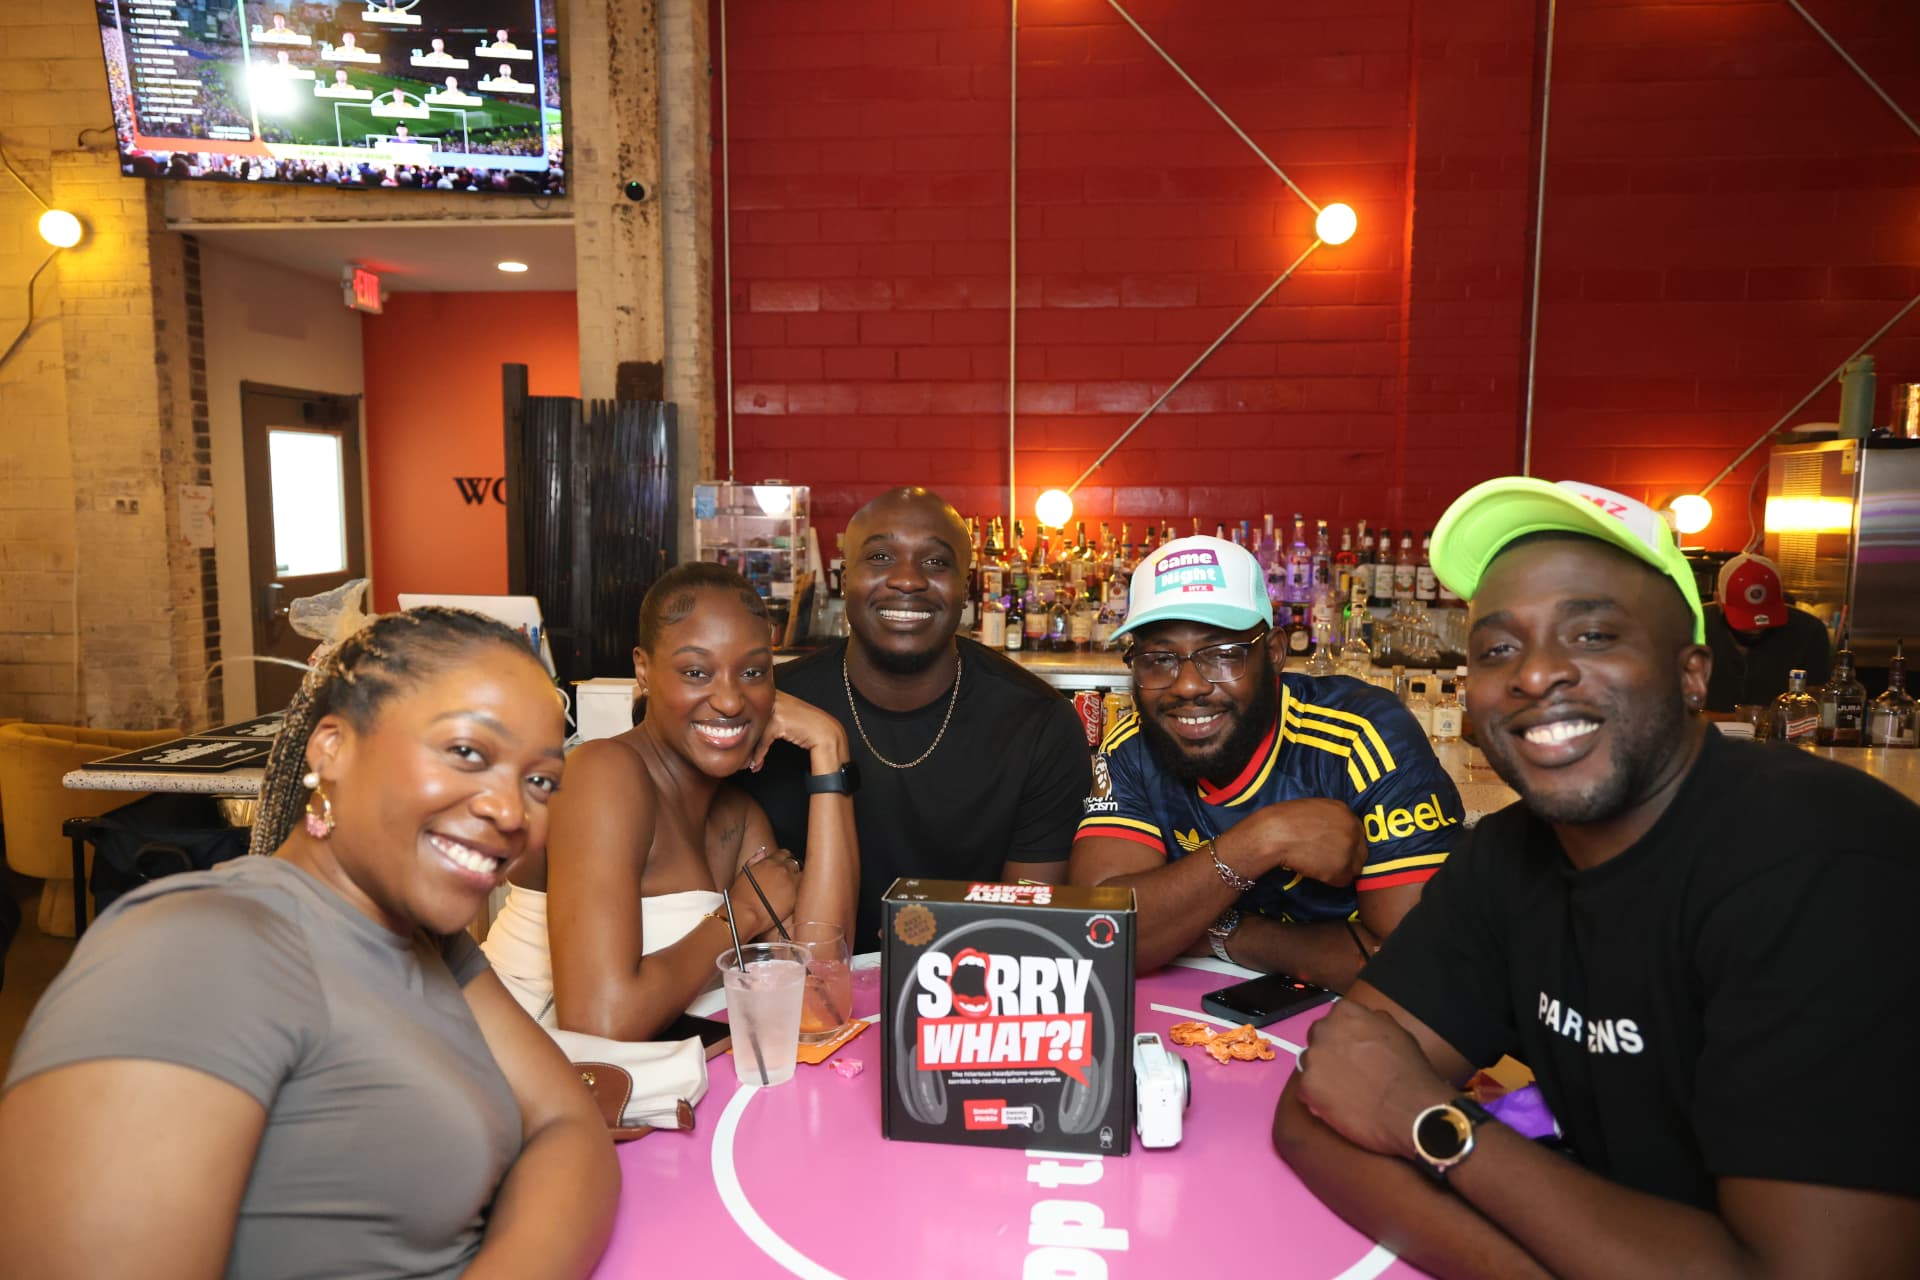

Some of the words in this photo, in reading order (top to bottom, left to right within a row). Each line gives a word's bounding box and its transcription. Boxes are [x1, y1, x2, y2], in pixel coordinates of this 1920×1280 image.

[1161, 567, 1217, 587] Night
[1363, 793, 1458, 843] deel.
[923, 1020, 1086, 1065] WHAT?!
[1022, 1149, 1130, 1280] opt
